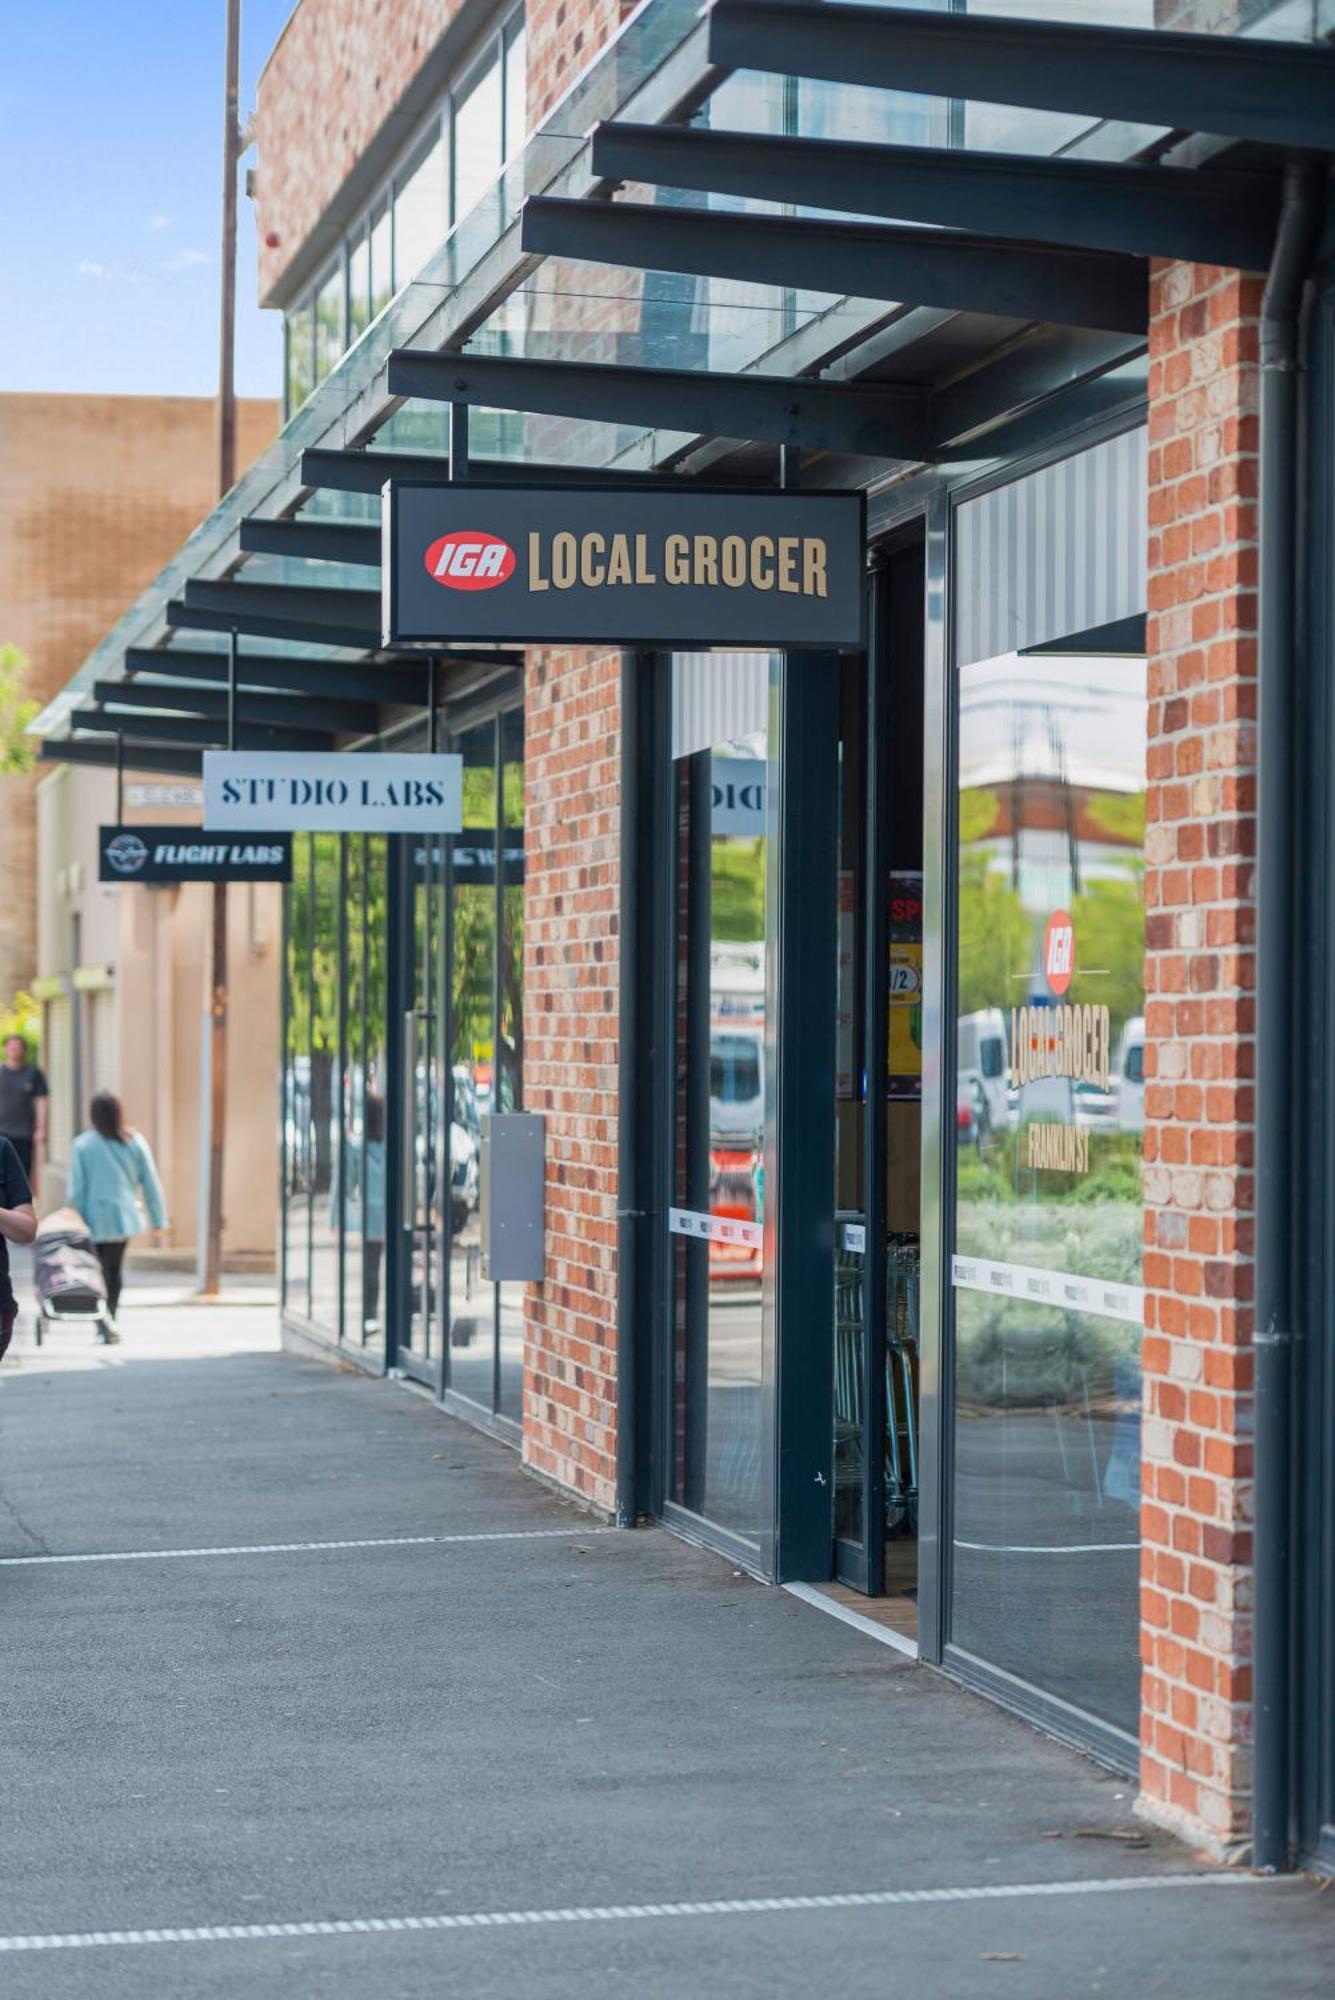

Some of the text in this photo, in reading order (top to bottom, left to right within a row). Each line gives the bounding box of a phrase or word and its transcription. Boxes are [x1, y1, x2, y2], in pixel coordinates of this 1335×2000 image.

[433, 531, 828, 598] IGA LOCAL GROCER
[222, 778, 348, 806] STUDIO
[360, 779, 445, 807] LABS
[154, 844, 284, 865] FLIGHT LABS
[1047, 927, 1072, 975] IGA
[1011, 1003, 1110, 1094] LOCAL GROCER
[1028, 1123, 1076, 1172] FRANKLIN
